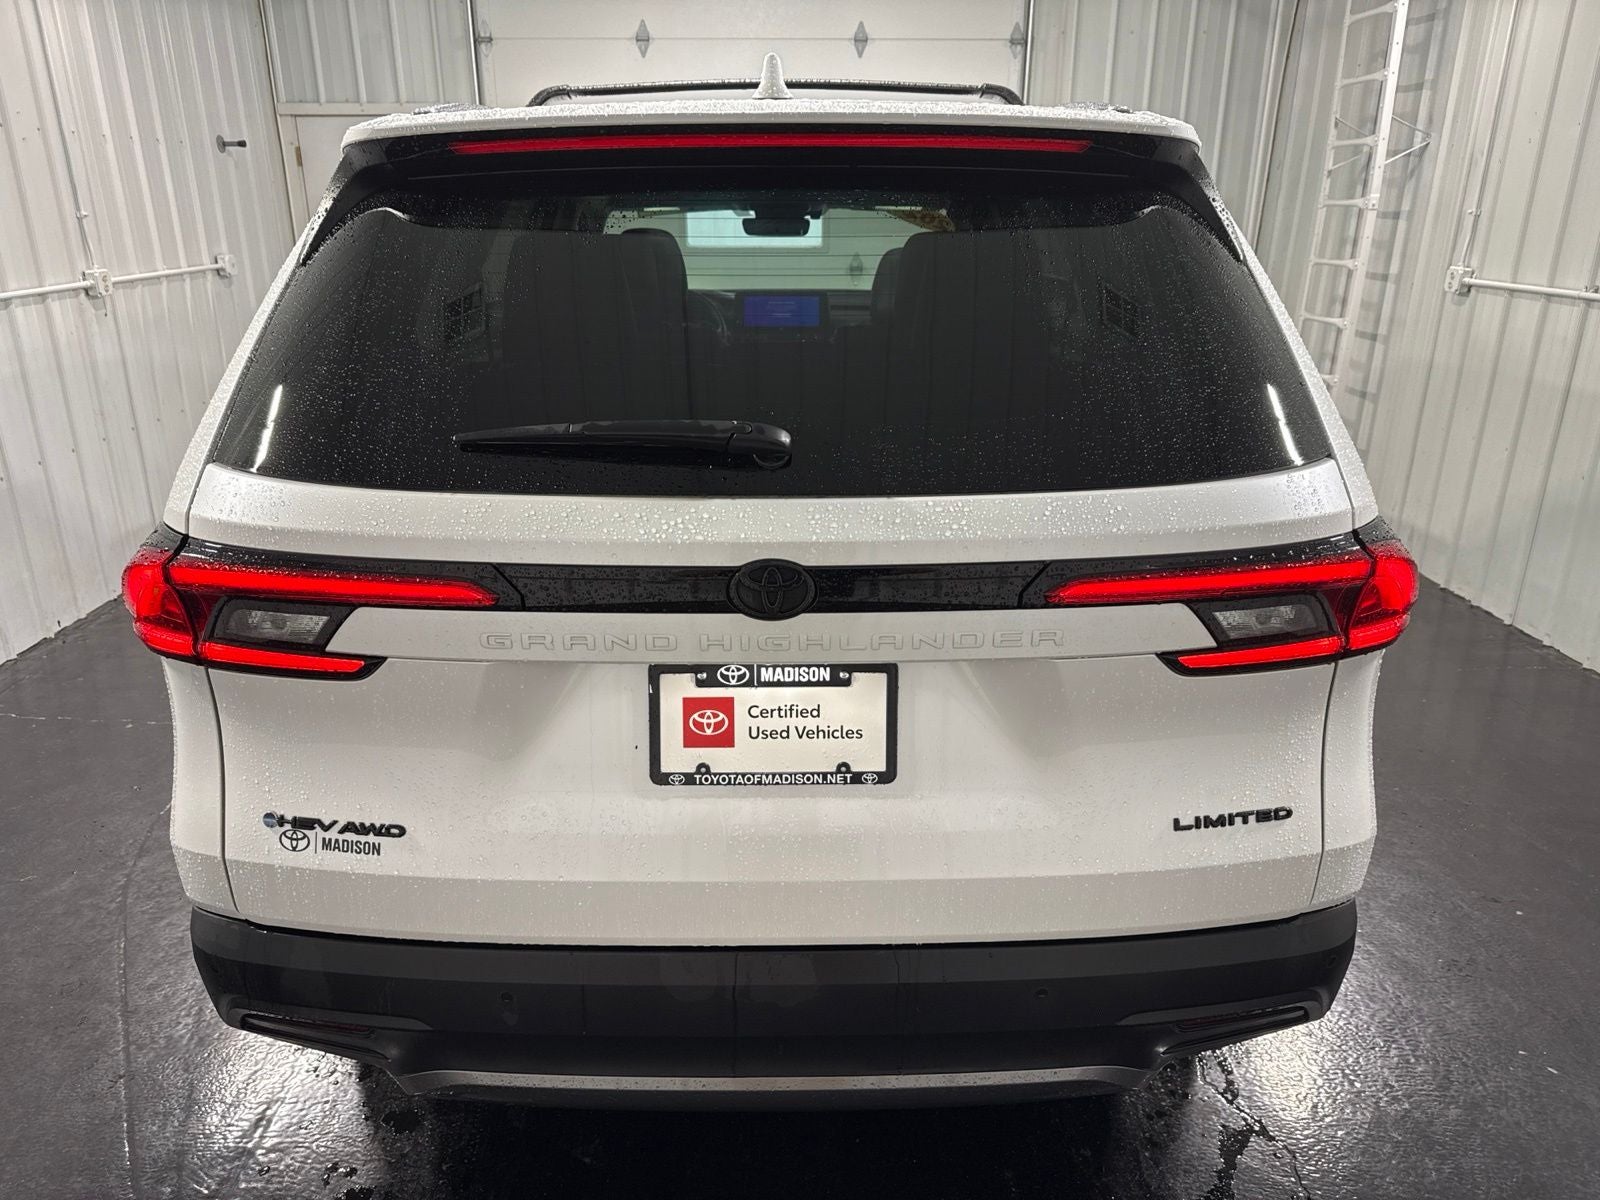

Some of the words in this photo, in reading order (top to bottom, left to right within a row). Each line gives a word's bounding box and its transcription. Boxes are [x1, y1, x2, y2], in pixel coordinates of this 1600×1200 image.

[479, 631, 678, 652] GRAND
[698, 628, 1065, 652] HIGHLANDER
[760, 666, 831, 683] MADISON
[747, 704, 821, 719] Certified
[748, 726, 790, 740] Used
[795, 725, 863, 740] Vehicles
[694, 773, 853, 785] TOYOTAOFMADISON.NET
[1173, 805, 1293, 832] LIMITED
[337, 820, 407, 839] AWD
[321, 837, 381, 856] MADISON
